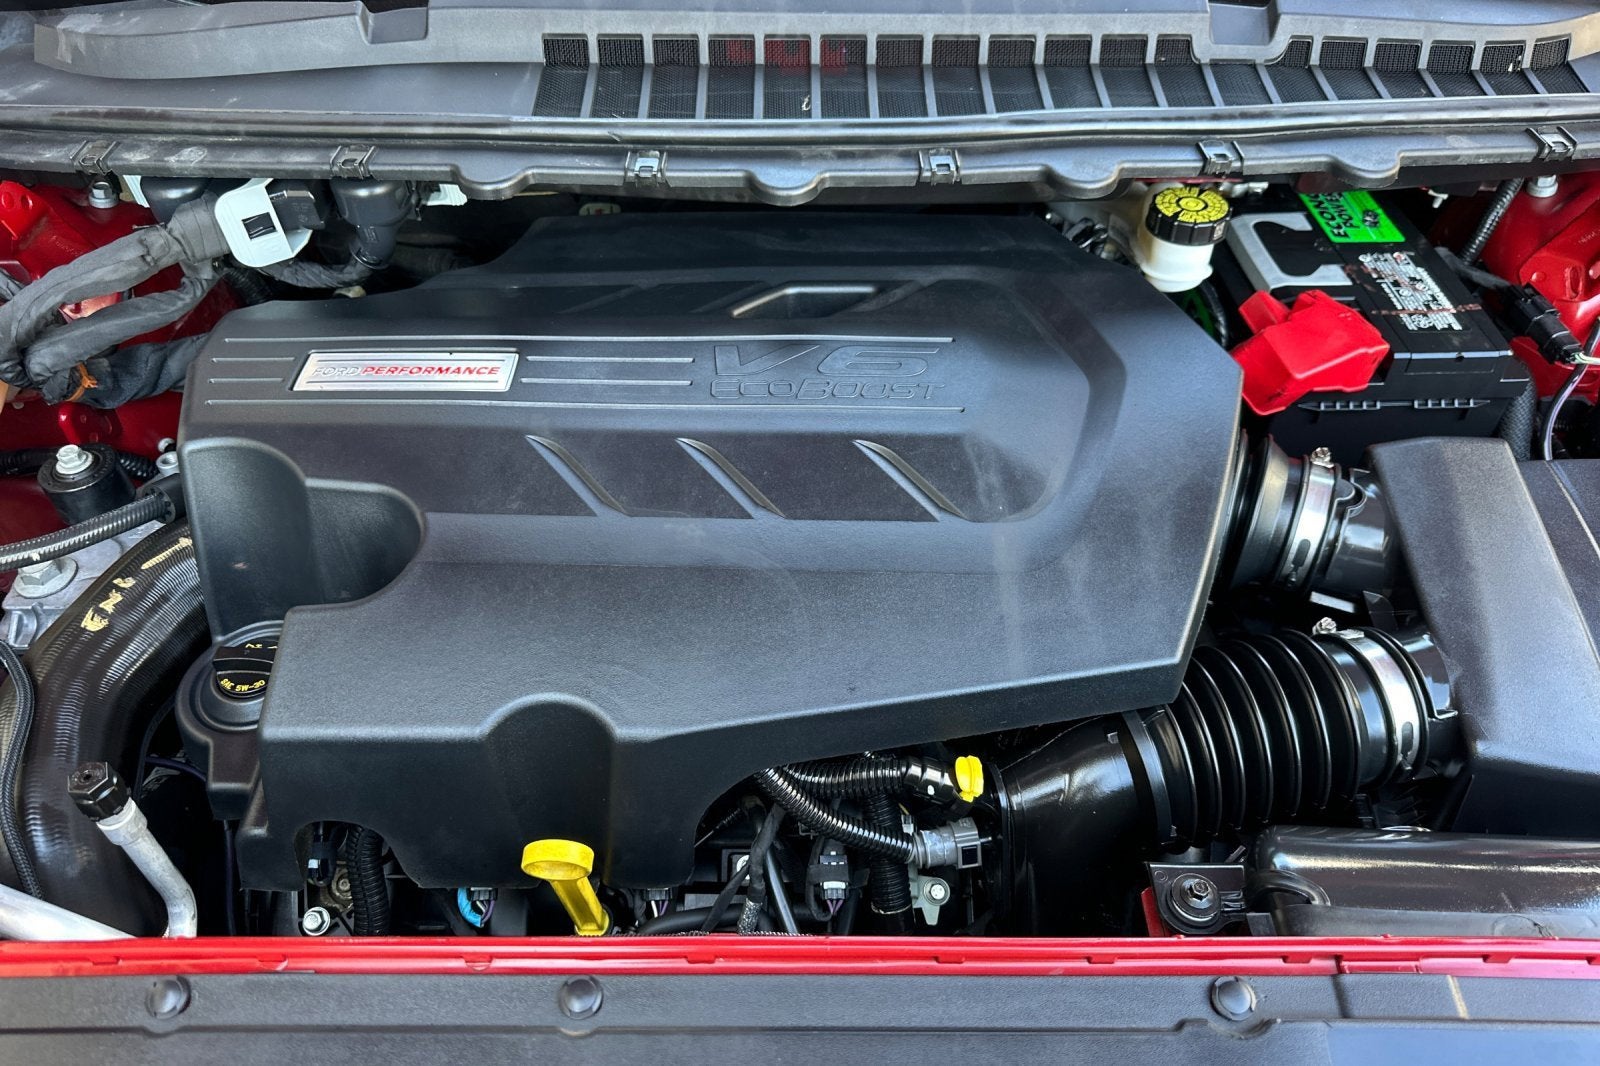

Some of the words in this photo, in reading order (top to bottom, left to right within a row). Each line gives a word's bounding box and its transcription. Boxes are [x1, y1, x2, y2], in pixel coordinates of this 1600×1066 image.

[713, 344, 941, 377] V6
[312, 365, 360, 377] FORD
[361, 365, 501, 377] PERFORMANCE
[220, 678, 235, 690] SAE
